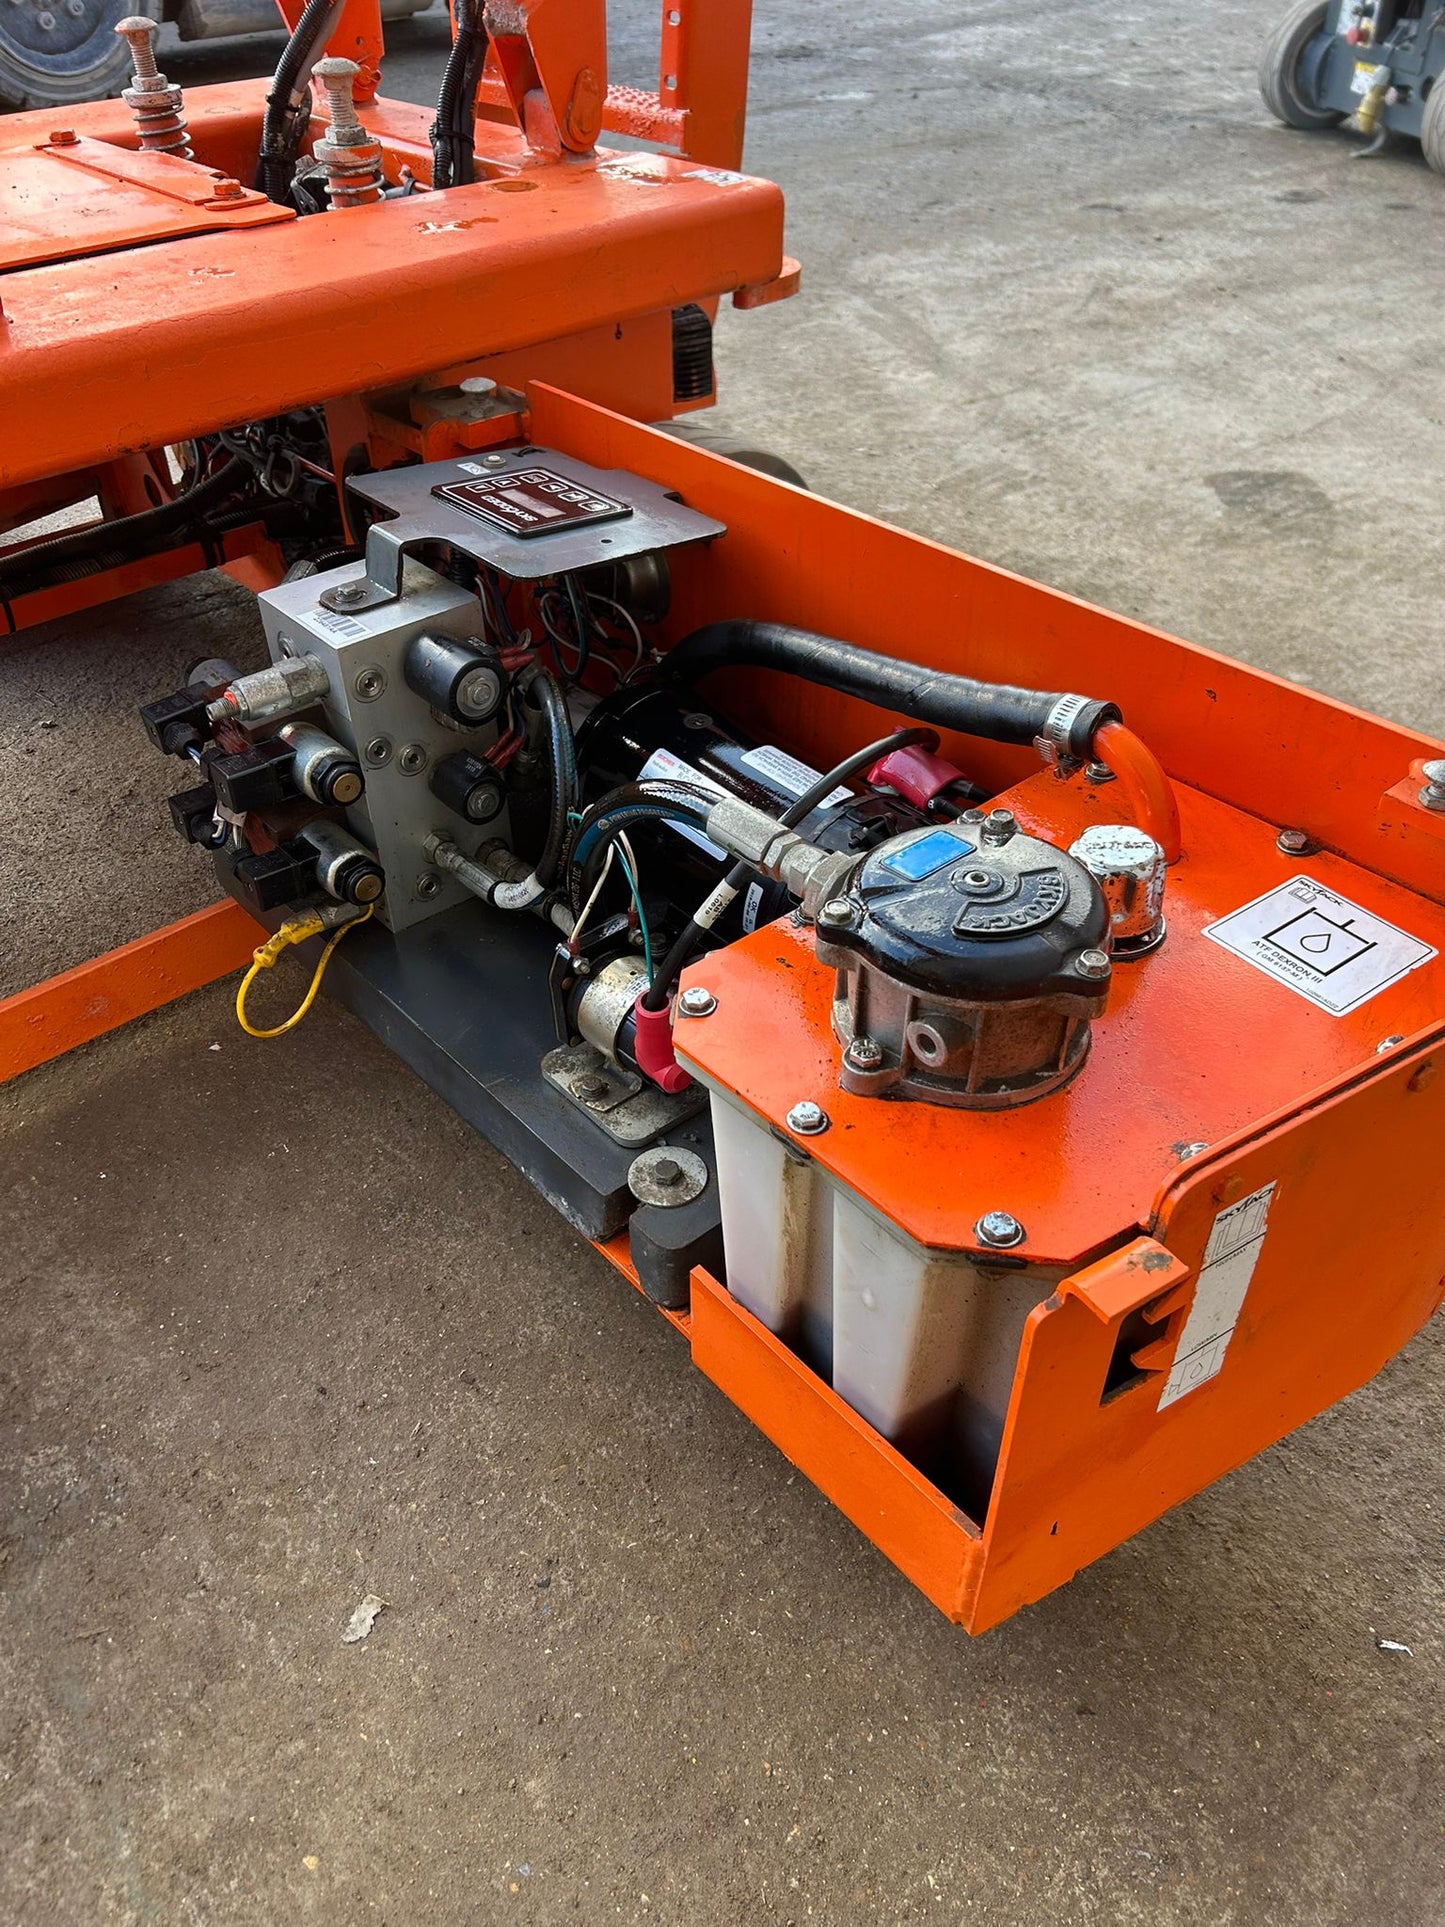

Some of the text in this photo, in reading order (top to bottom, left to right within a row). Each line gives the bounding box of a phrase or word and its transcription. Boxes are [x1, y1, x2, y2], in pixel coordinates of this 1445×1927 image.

[964, 874, 1062, 929] SKYJACK
[1299, 880, 1344, 906] SKYJACK
[1252, 940, 1272, 952] ATF
[1271, 951, 1312, 977] DEXRON
[1216, 1188, 1274, 1225] SKYJAC
